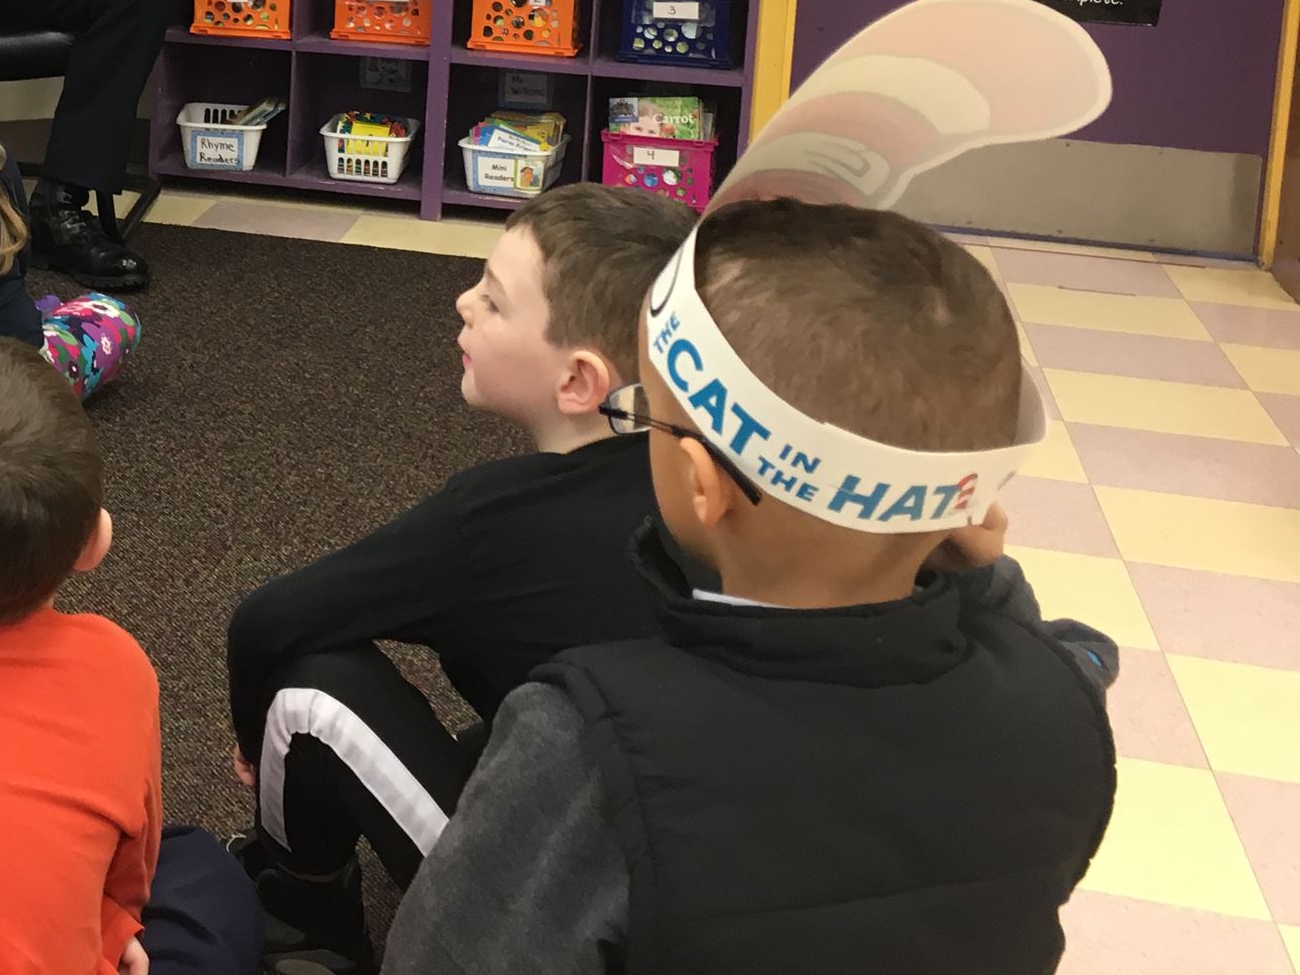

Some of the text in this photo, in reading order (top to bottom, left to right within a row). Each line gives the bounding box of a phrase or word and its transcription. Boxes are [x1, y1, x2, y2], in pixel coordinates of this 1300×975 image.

[668, 5, 676, 15] 3
[652, 113, 695, 124] Carrot
[200, 137, 236, 153] Rhyme
[199, 153, 241, 165] Readers
[491, 164, 508, 172] Mini
[484, 174, 515, 182] Readers
[653, 313, 772, 457] THE CAT
[779, 444, 822, 474] IN
[756, 456, 819, 503] THE
[827, 473, 958, 522] HAT
